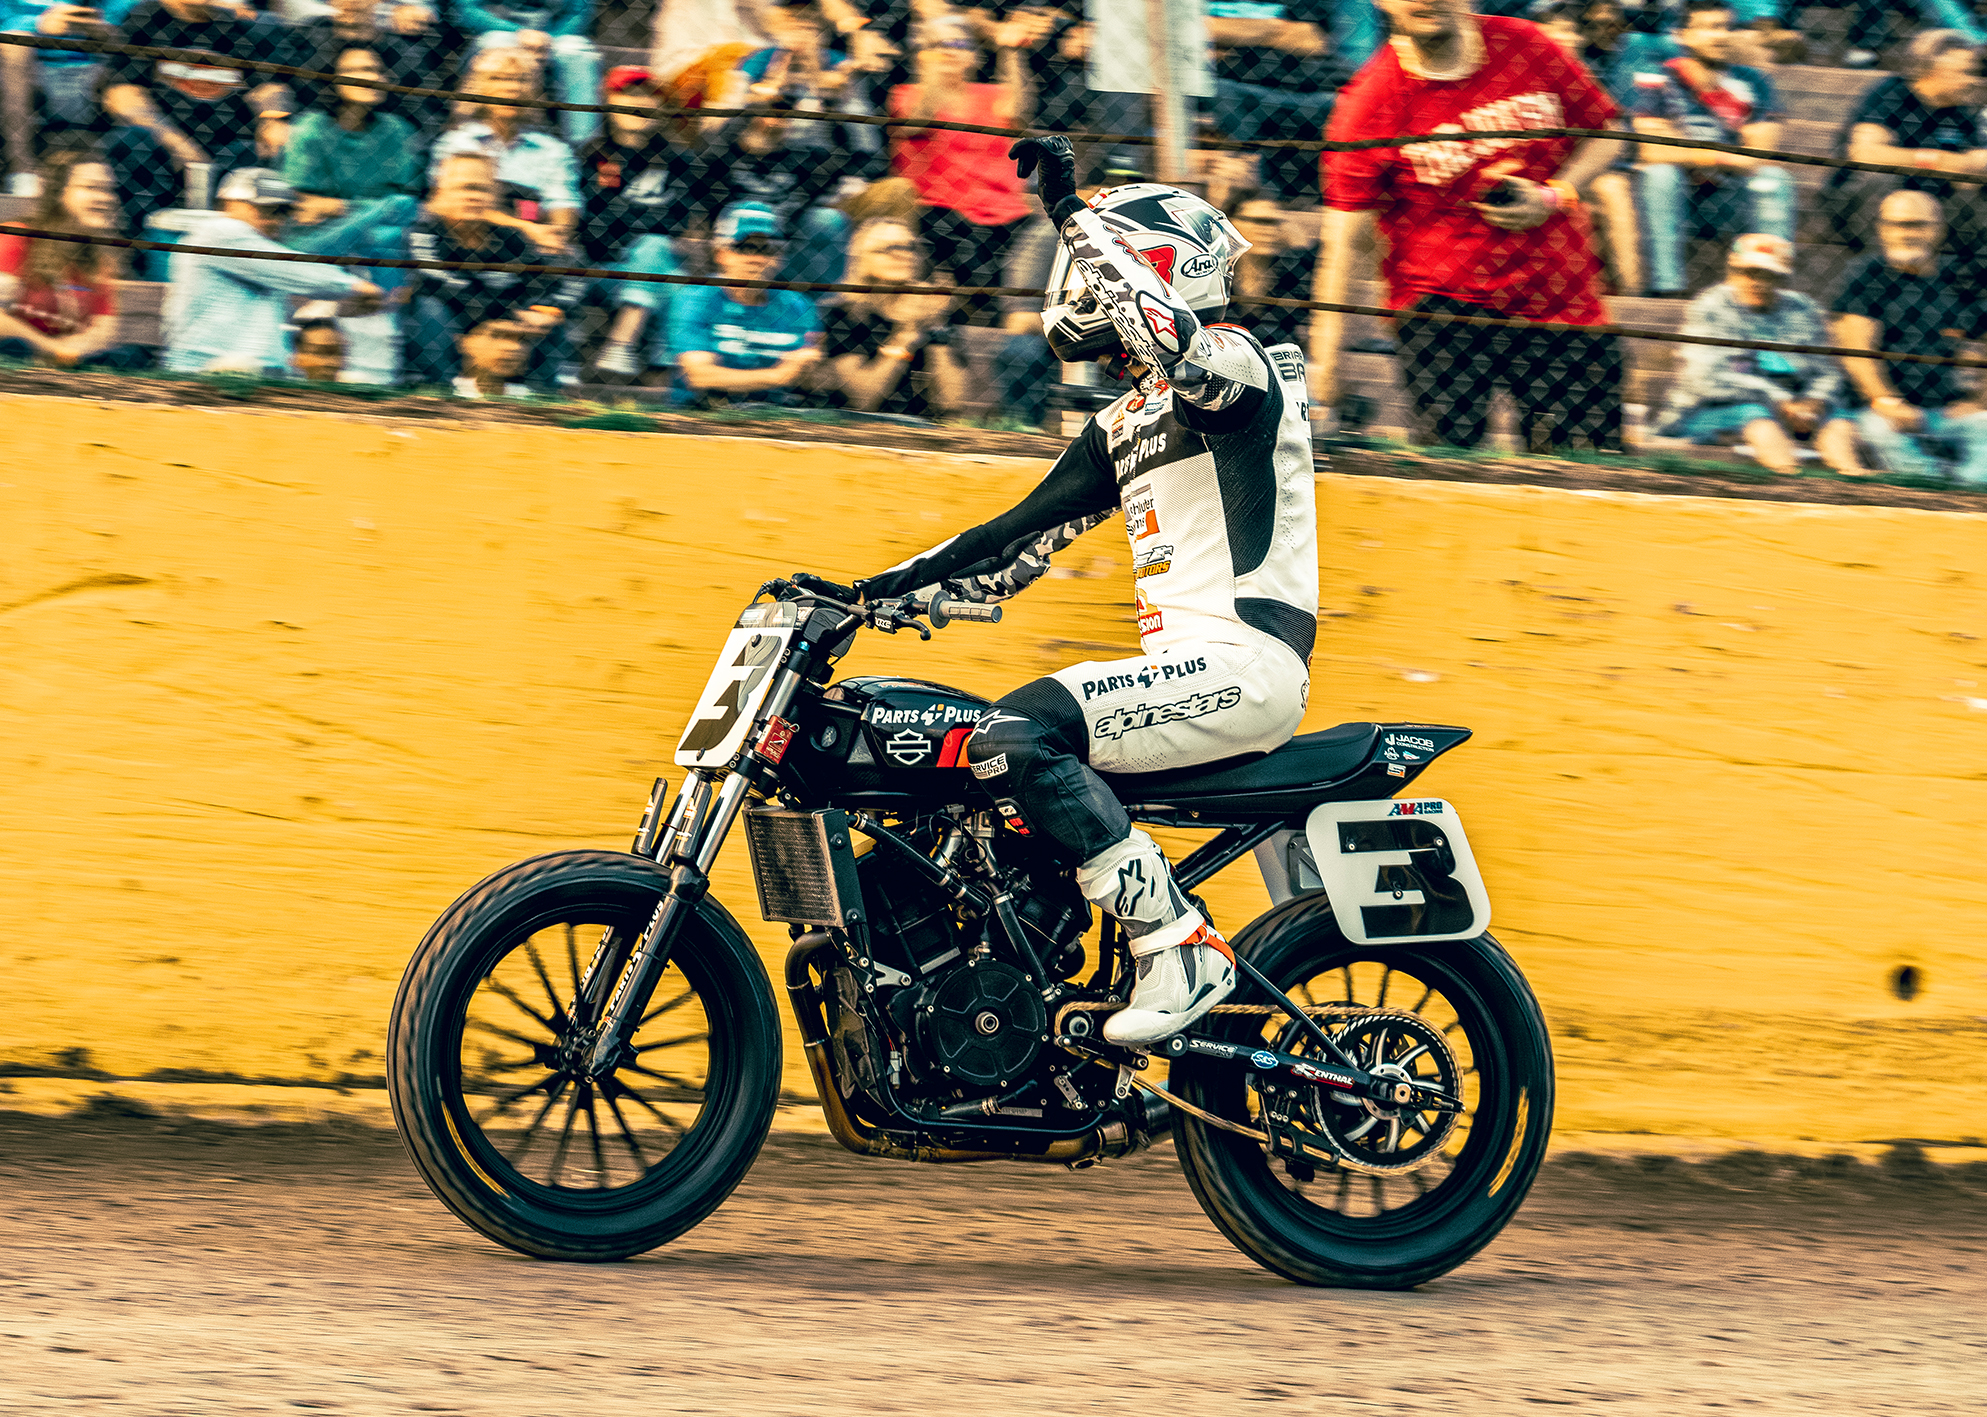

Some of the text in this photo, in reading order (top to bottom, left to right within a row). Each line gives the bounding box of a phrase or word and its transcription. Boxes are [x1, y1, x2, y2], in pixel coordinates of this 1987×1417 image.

[1081, 656, 1207, 701] PARTS PLUS
[871, 706, 982, 724] PARTS PLUS
[1094, 685, 1241, 741] alpinestars
[1395, 734, 1435, 748] JACOB
[987, 763, 1007, 776] PRO
[1387, 801, 1443, 816] AMA PRO
[1336, 818, 1475, 938] 3
[1189, 1039, 1238, 1053] SERVICE
[1293, 1062, 1354, 1086] RENTHAL
